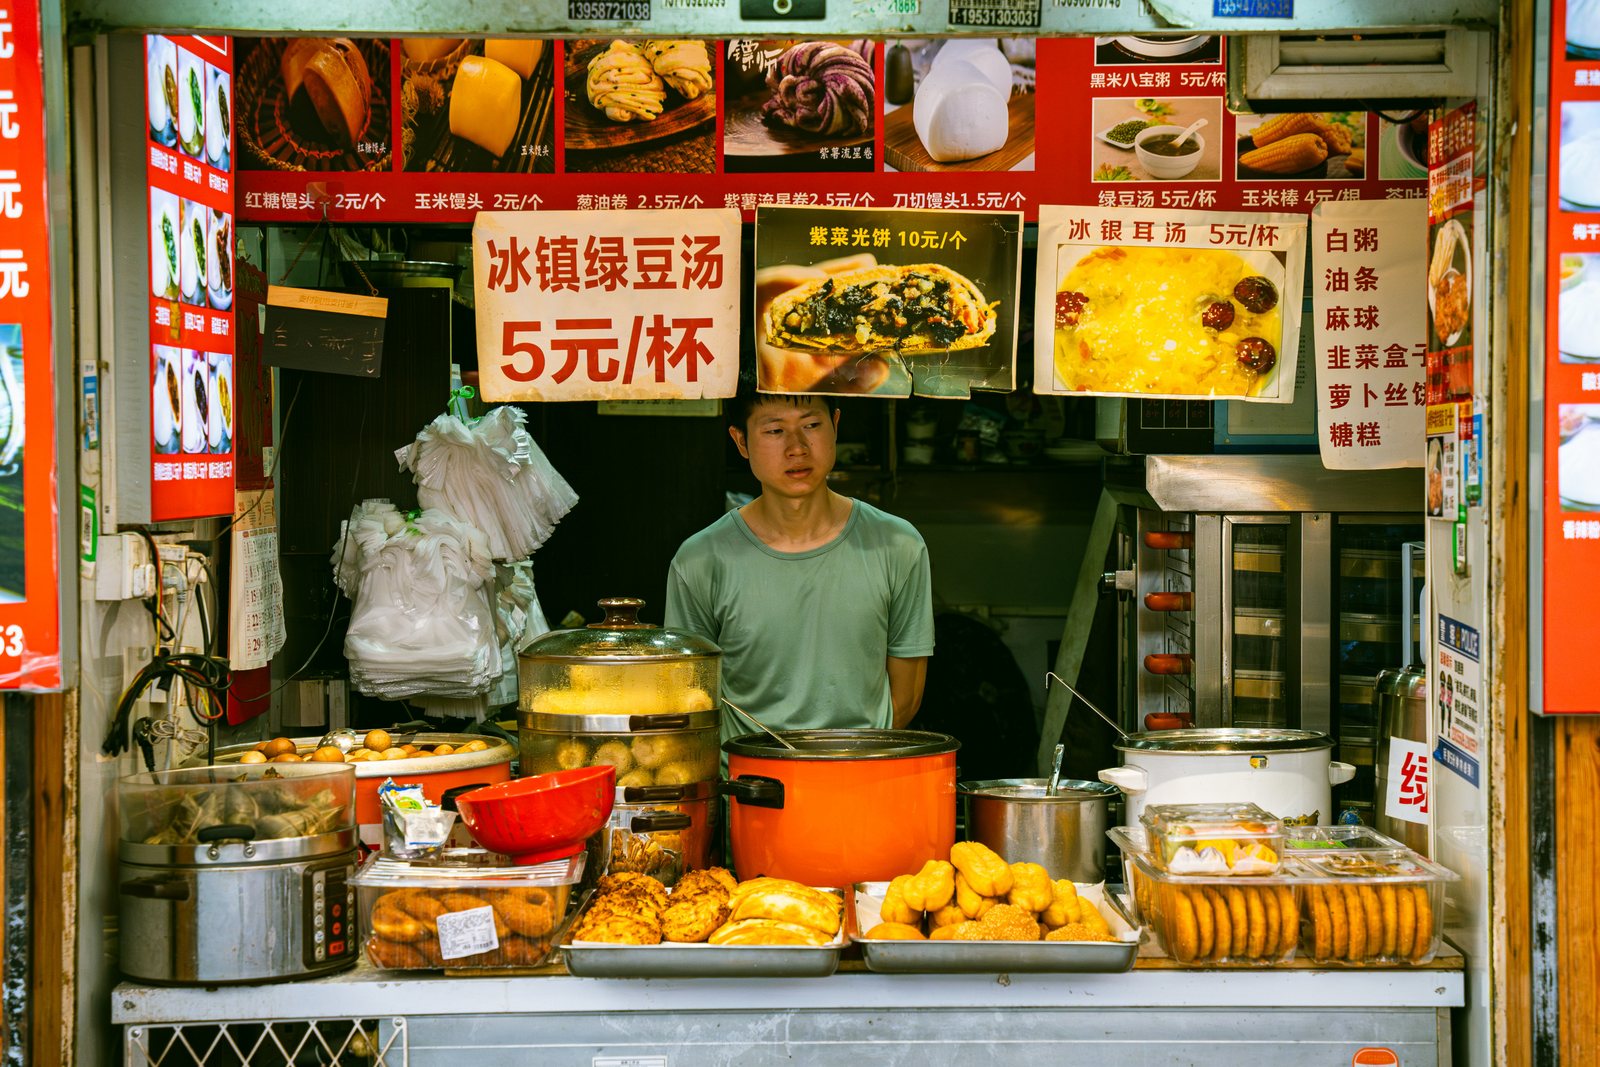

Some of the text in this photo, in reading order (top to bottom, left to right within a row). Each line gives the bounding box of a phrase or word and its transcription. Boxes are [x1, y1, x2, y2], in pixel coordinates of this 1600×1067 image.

[569, 2, 649, 19] 13958721038
[1090, 71, 1226, 88] 黑米八宝粥 5元/杯
[245, 192, 386, 209] 红糖馒头 2元/个
[415, 193, 544, 210] 玉米馒头 2元/个
[577, 194, 704, 210] 葱油卷 2.5元/个
[1098, 190, 1217, 207] 绿豆汤 5元/杯
[1242, 189, 1299, 207] 玉米棒
[1386, 188, 1427, 199] 茶叶
[809, 226, 967, 250] 紫菜光饼 10元/个
[1068, 219, 1279, 247] 冰银耳汤 5元/杯
[1326, 228, 1379, 253] 白粥
[487, 234, 723, 293] 冰镇绿豆汤
[1325, 266, 1379, 292] 油条
[1325, 305, 1380, 331] 麻球
[500, 314, 715, 384] 5元/杯
[1329, 421, 1382, 448] 糖糕
